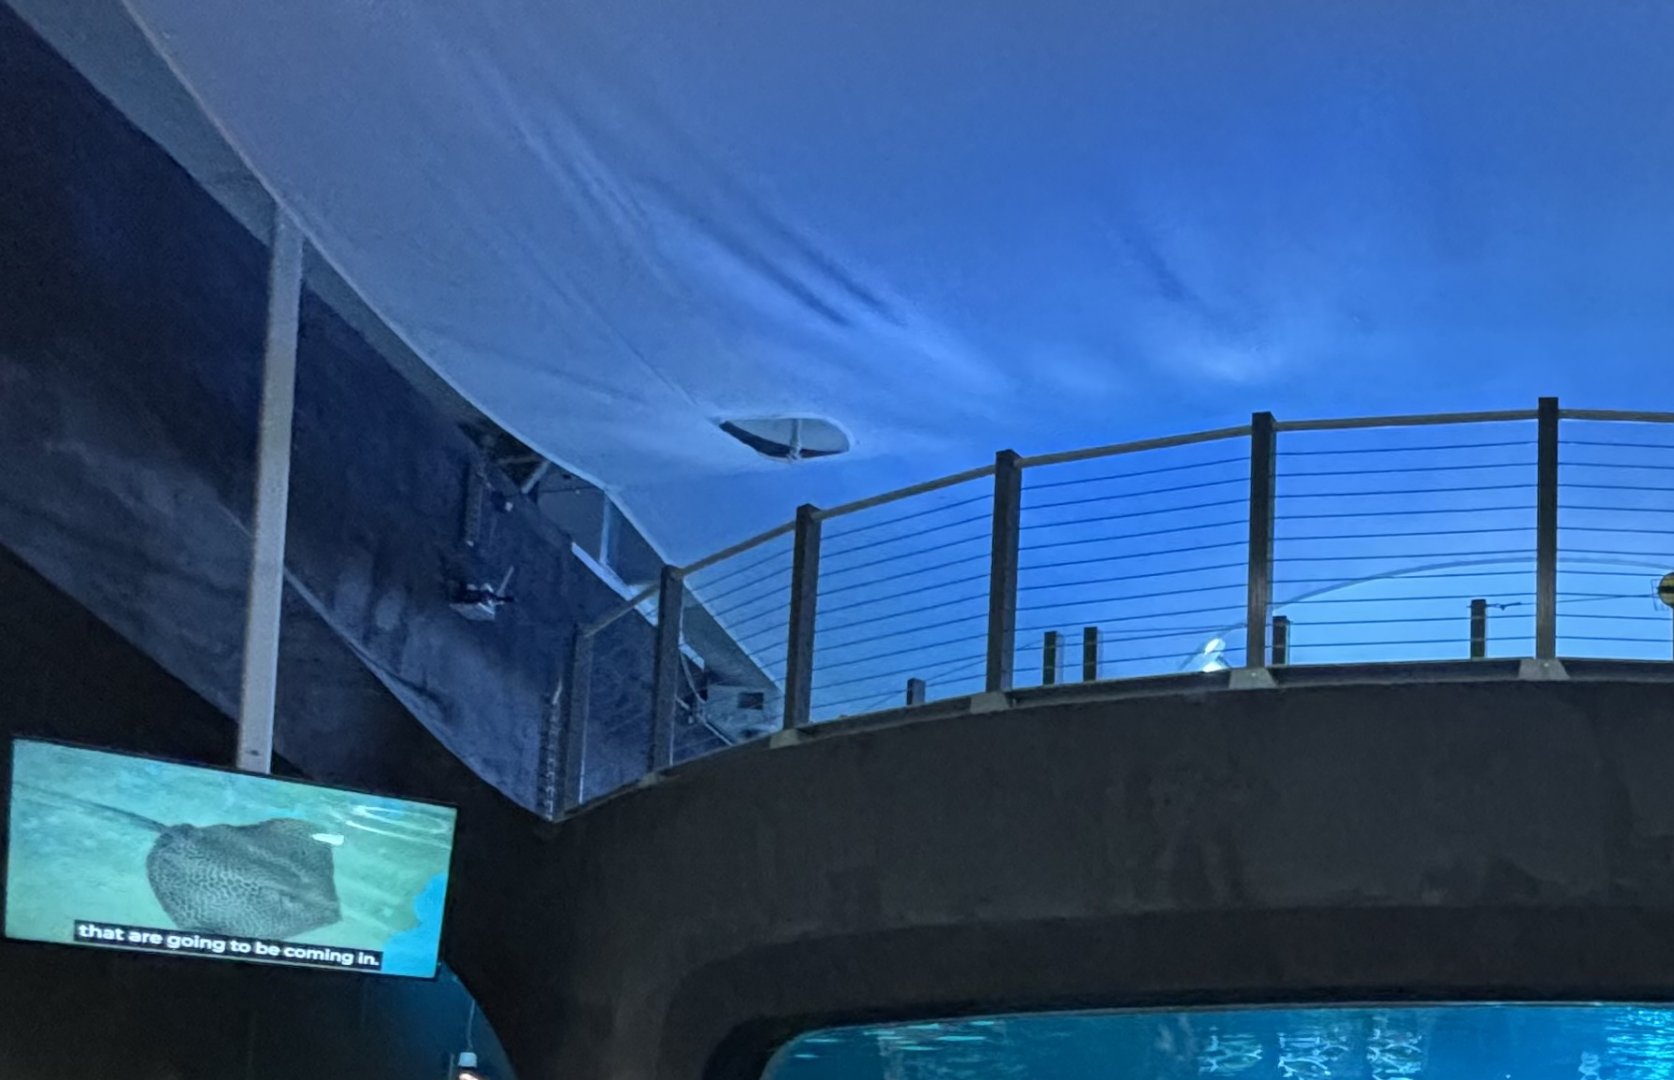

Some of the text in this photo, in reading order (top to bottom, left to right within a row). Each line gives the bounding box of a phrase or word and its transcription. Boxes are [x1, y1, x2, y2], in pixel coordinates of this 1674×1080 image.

[78, 924, 379, 967] that are going to be coming in.
